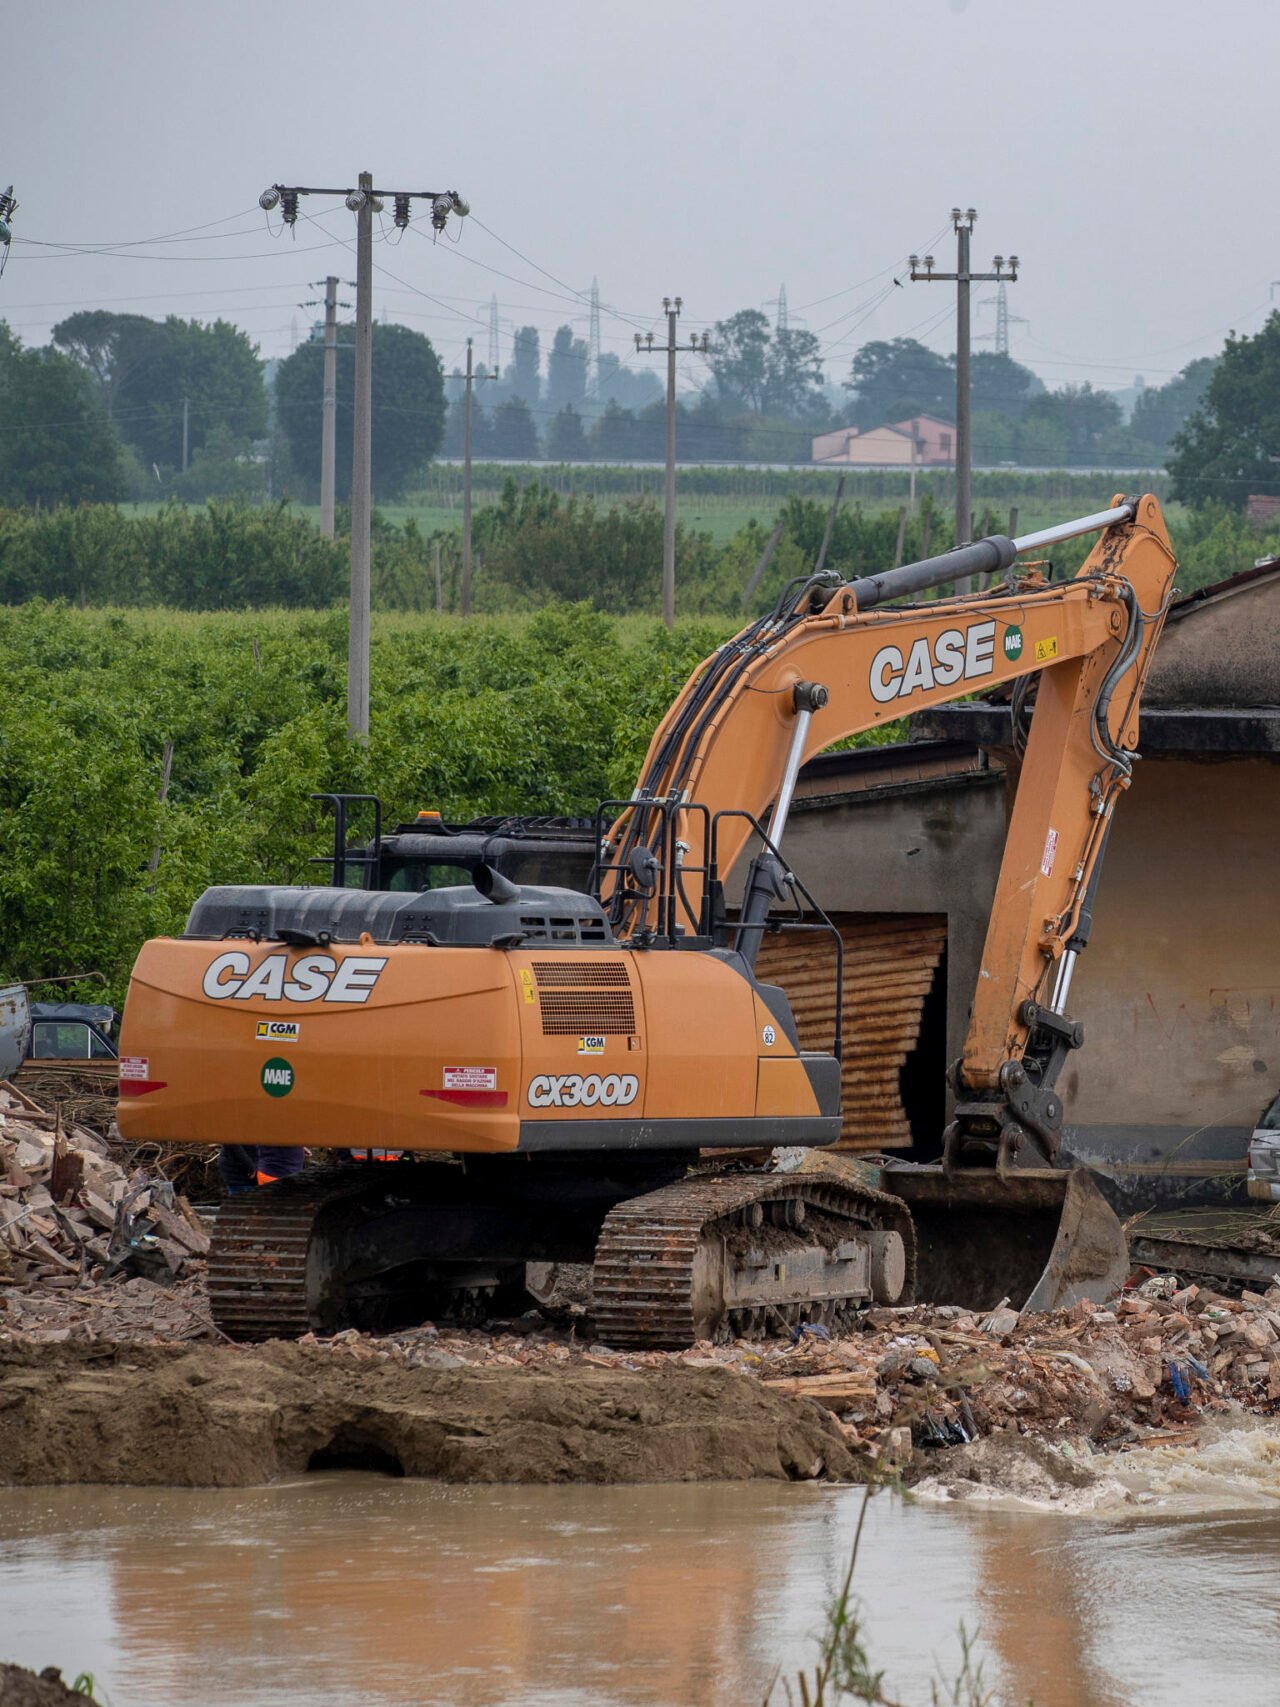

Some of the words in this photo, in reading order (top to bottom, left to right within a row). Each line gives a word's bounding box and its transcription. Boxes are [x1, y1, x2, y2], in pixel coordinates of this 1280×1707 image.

[1005, 634, 1021, 650] MAIE
[869, 619, 996, 703] CASE
[202, 951, 389, 1003] CASE
[270, 1023, 297, 1034] CGM
[586, 1037, 604, 1047] CGM
[765, 1032, 774, 1043] 82
[264, 1069, 291, 1085] MAIE
[528, 1073, 639, 1108] CX300D
